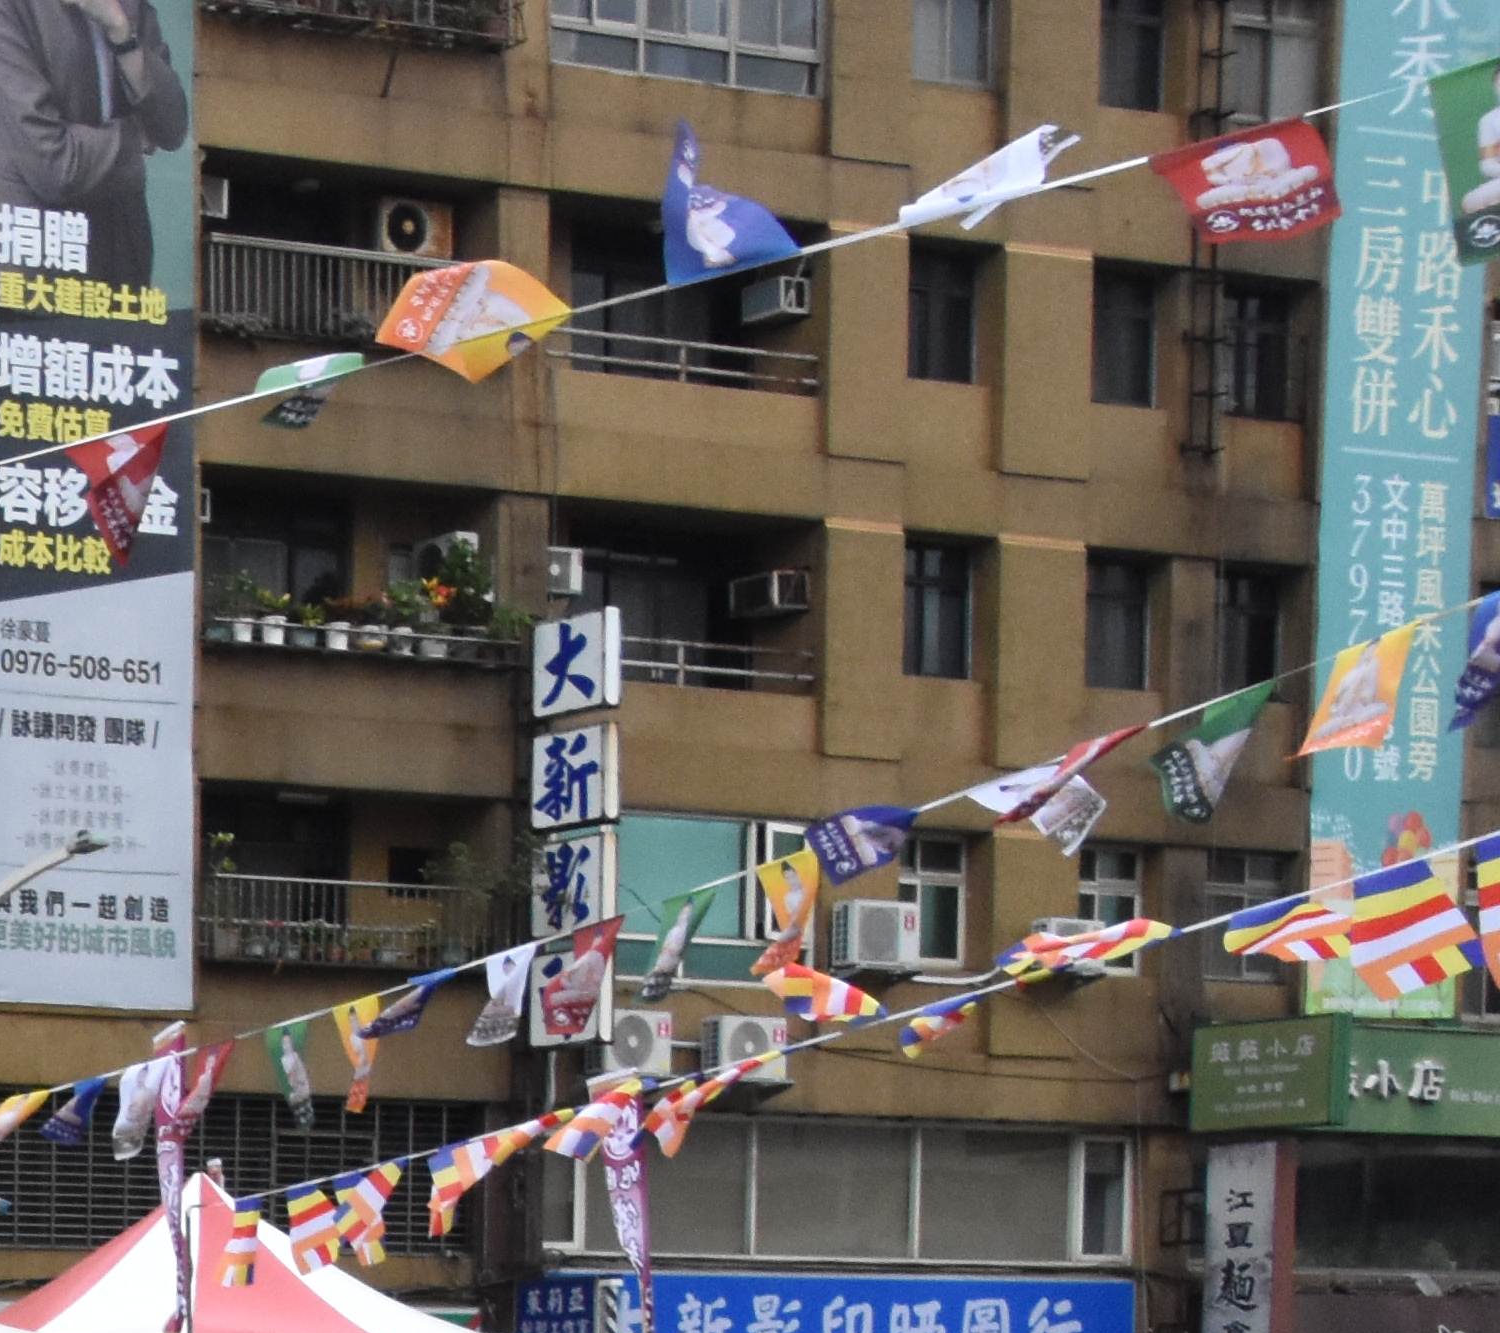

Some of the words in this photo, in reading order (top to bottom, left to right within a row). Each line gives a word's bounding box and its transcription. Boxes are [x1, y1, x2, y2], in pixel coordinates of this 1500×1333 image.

[1344, 474, 1372, 782] 37970
[0, 649, 162, 685] 0976-508-651
[1348, 1058, 1444, 1101] 小店
